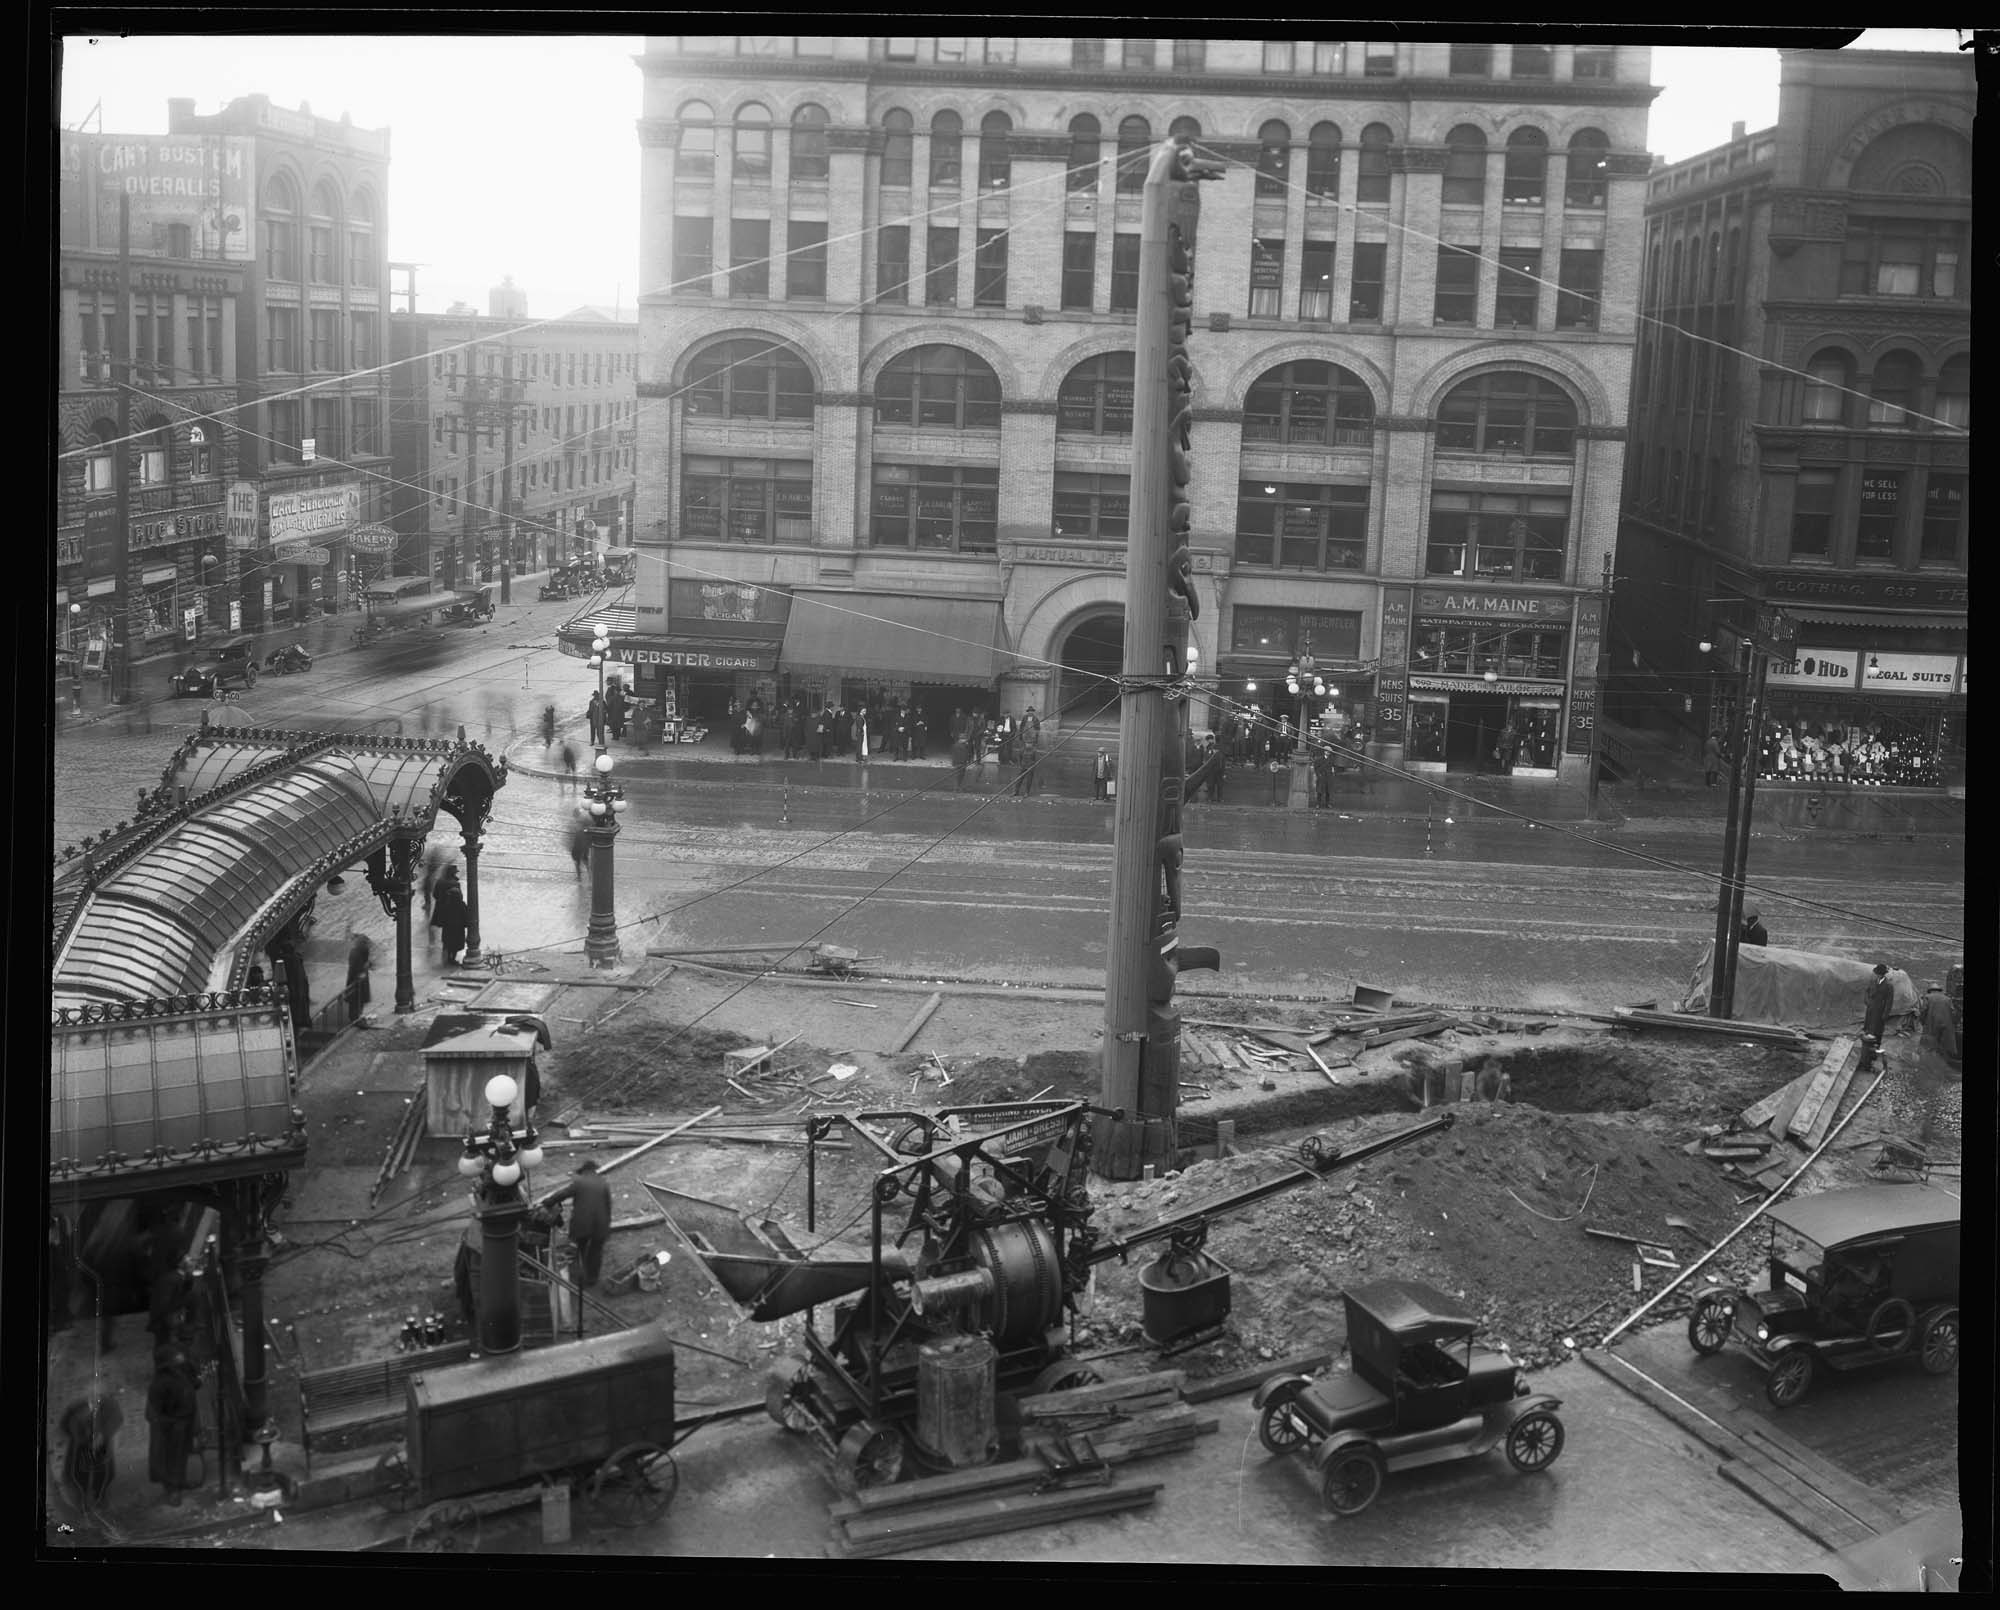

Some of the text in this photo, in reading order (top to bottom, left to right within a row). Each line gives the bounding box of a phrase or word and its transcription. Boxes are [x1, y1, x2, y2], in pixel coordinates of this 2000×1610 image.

[125, 175, 220, 197] OVERALLS
[1878, 479, 1897, 489] SELL
[1878, 491, 1897, 501] LESS
[230, 492, 253, 513] THE
[227, 517, 258, 537] ARMY
[129, 521, 167, 545] RUG
[349, 534, 395, 545] BAKERY
[1483, 597, 1540, 614] MAINE
[1384, 615, 1408, 626] MAINE
[1419, 618, 1492, 627] SATISFACTION
[619, 648, 758, 668] WEBSTER CIGARS
[1818, 659, 1849, 678] HUB
[1911, 672, 1952, 683] SUITS
[1440, 680, 1473, 690] MAINE
[1379, 692, 1403, 703] SUITS
[1571, 701, 1595, 712] SUITS
[1006, 1128, 1029, 1145] JAHN
